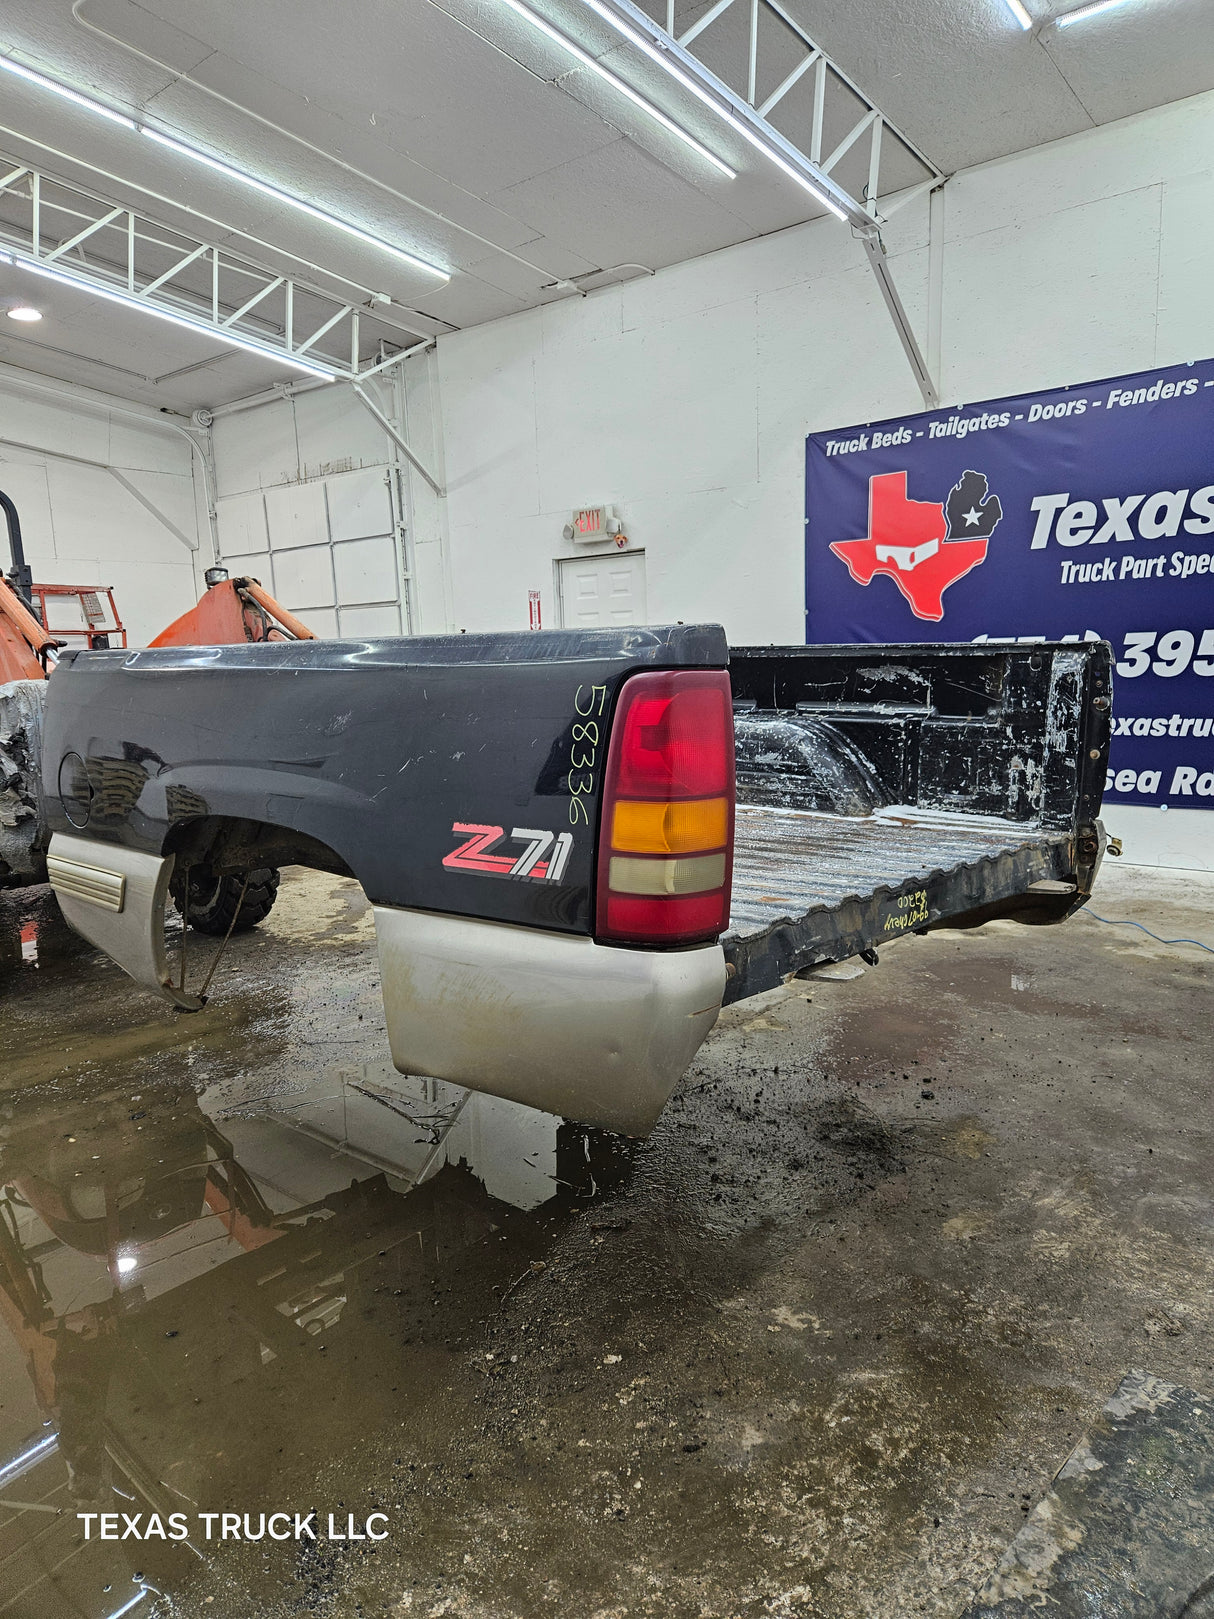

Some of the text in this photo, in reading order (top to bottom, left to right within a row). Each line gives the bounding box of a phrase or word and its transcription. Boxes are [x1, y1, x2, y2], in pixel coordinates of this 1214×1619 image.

[826, 433, 869, 457] Truck
[871, 426, 913, 450] Beds
[928, 413, 1011, 439] Tailgates
[1028, 398, 1088, 423] Doors
[1106, 378, 1199, 410] Fenders
[579, 508, 601, 533] EXIT
[1060, 557, 1118, 584] Truck
[1119, 554, 1167, 580] Part
[568, 684, 607, 826] 58336
[442, 821, 575, 886] Z71
